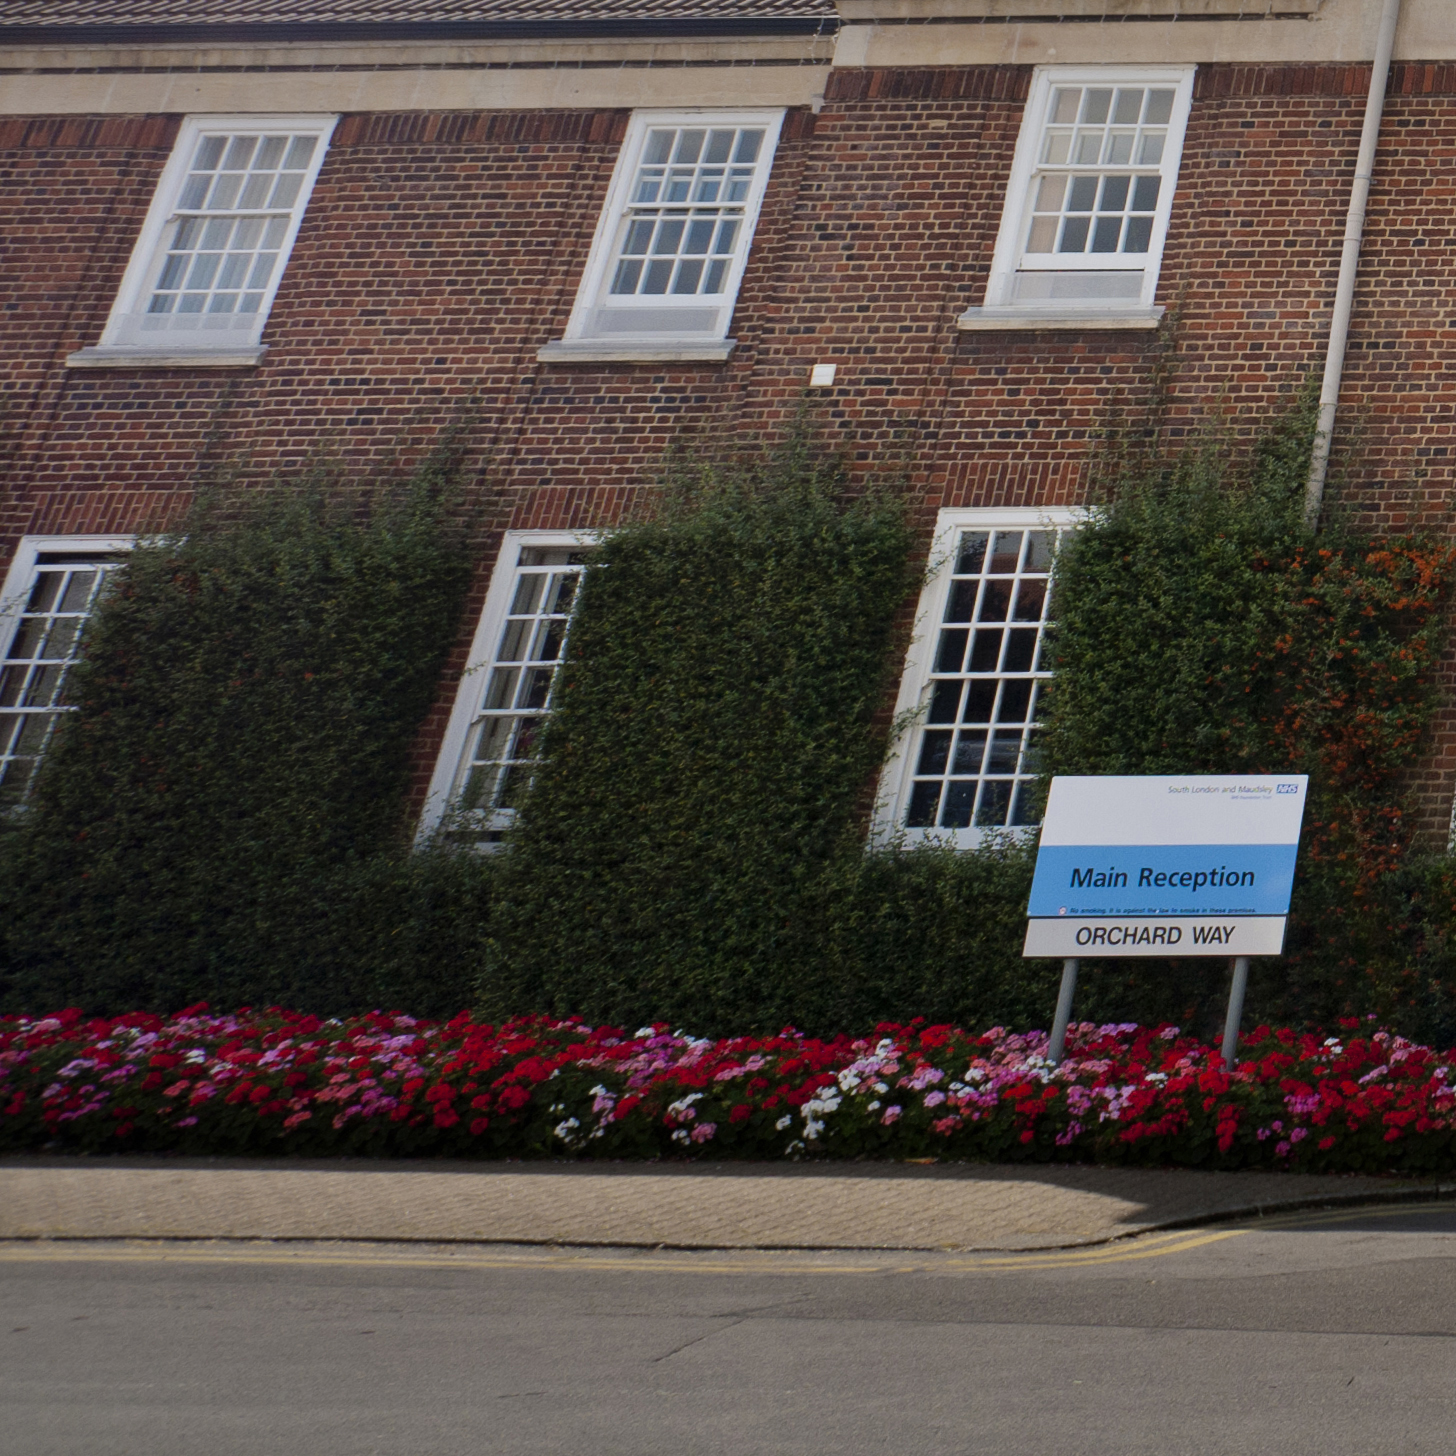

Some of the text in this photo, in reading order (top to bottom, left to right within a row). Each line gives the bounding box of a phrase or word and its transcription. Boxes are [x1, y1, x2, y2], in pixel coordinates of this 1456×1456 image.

[1168, 784, 1298, 795] South London and Maudsley NHS
[1070, 865, 1255, 892] Main Reception
[1123, 907, 1146, 915] against
[1076, 925, 1236, 945] ORCHARD WAY
